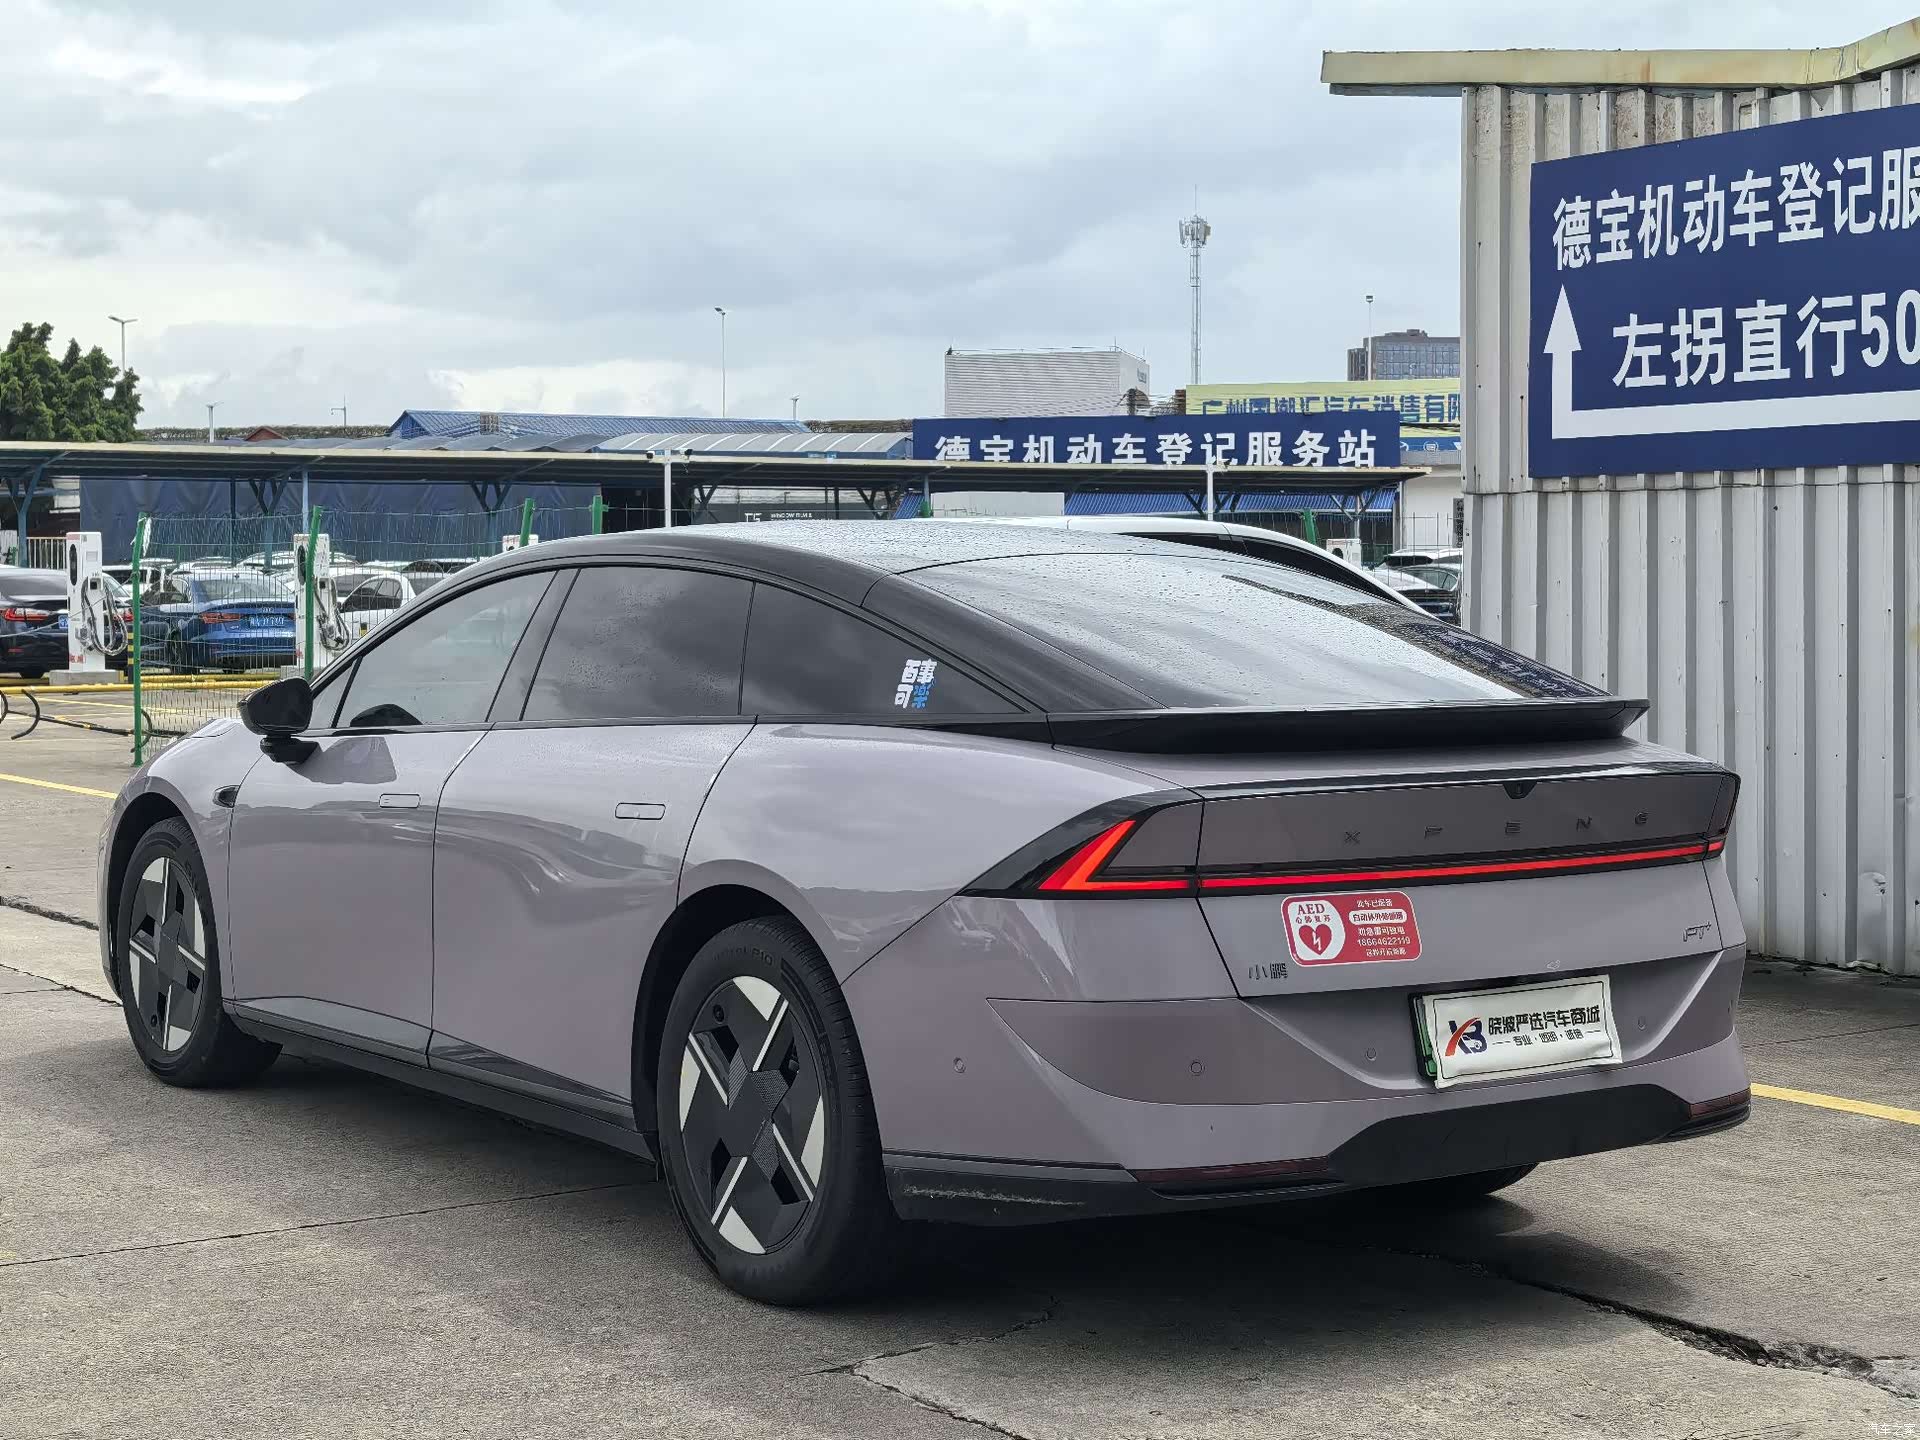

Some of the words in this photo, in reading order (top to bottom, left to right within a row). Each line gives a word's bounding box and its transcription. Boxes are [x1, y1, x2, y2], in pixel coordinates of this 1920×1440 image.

[1553, 146, 1920, 270] 德宝机动车登记服
[1612, 289, 1920, 388] 左拐直行50
[935, 429, 1377, 467] 德宝机动车登记服务站
[1345, 810, 1649, 844] XPENG
[1298, 904, 1325, 915] AED
[1249, 963, 1288, 980] 小鹏
